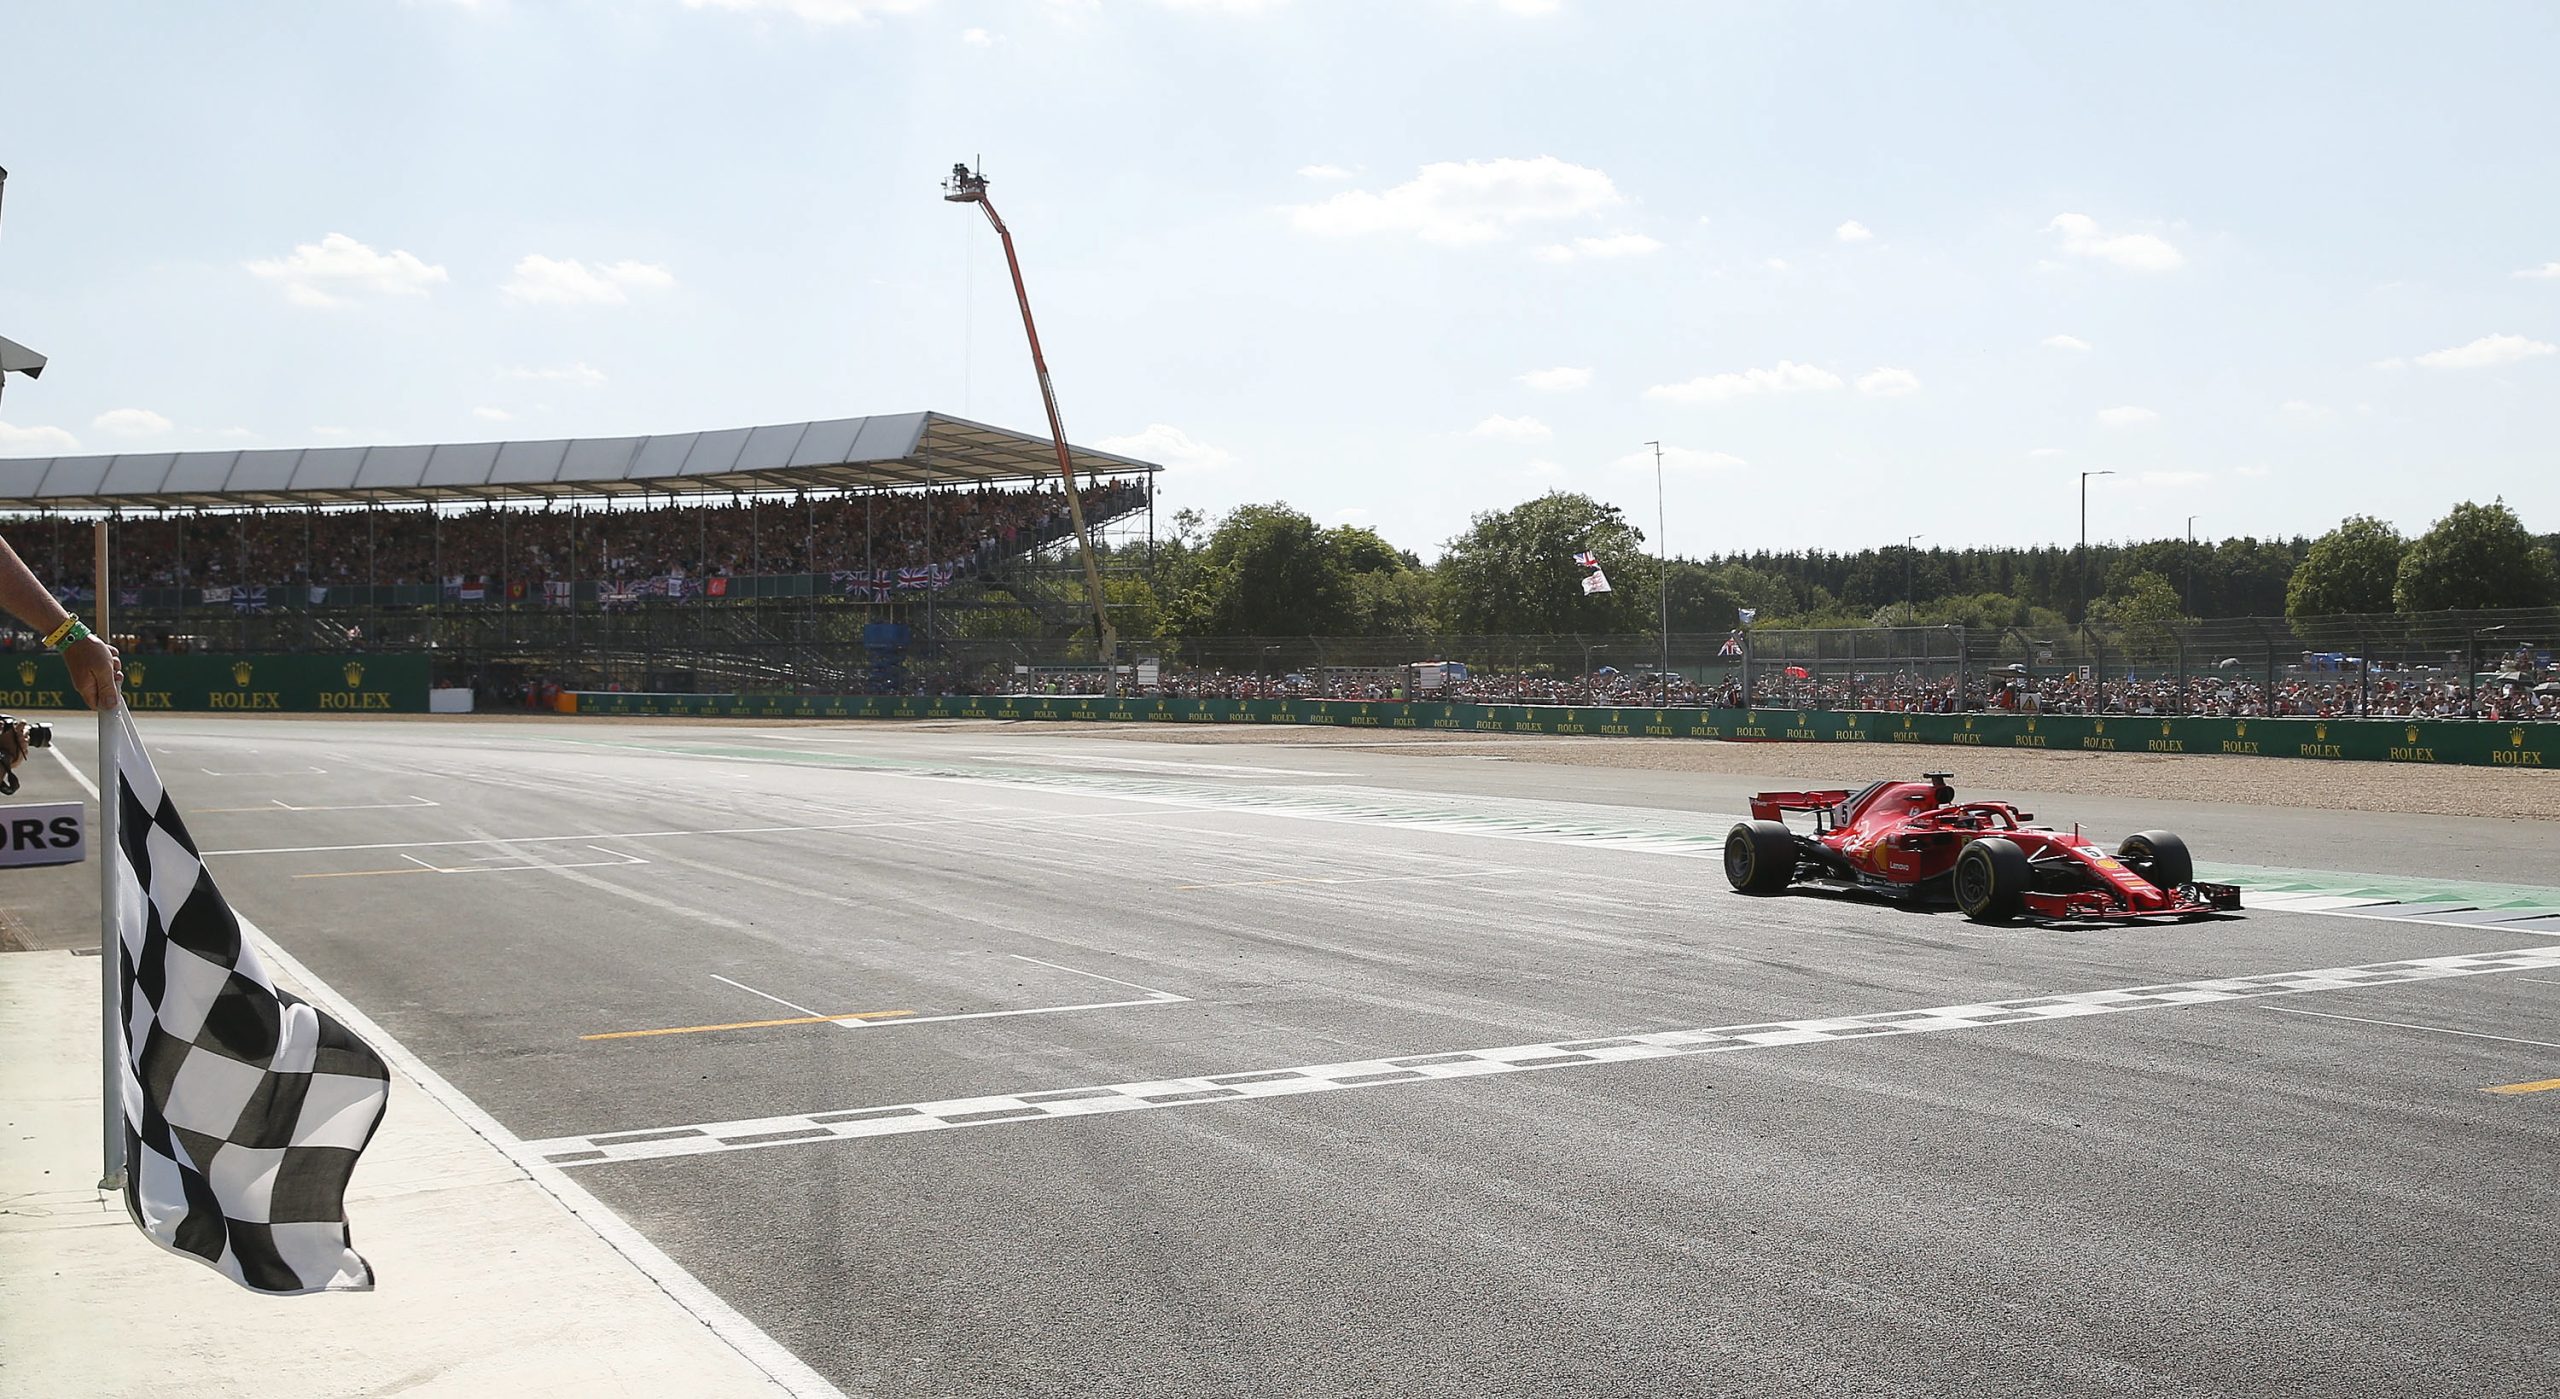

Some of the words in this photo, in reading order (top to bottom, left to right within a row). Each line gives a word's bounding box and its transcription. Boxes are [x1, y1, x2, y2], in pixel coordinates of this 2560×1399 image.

[2081, 667, 2088, 678] F
[209, 692, 280, 708] ROLEX
[320, 692, 391, 708] ROLEX
[1272, 714, 1296, 722] ROLEX
[1310, 715, 1334, 723] ROLEX
[1352, 716, 1378, 725] ROLEX
[1394, 717, 1416, 726] ROLEX
[1434, 719, 1459, 727] ROLEX
[1477, 720, 1502, 729] ROLEX
[1517, 722, 1543, 731] ROLEX
[1558, 724, 1583, 733] ROLEX
[1602, 725, 1628, 734] ROLEX
[1646, 726, 1672, 735] ROLEX
[1691, 727, 1718, 736] ROLEX
[1736, 727, 1765, 737] ROLEX
[1787, 729, 1815, 740] ROLEX
[1836, 730, 1866, 740] ROLEX
[1894, 732, 1919, 742] ROLEX
[1953, 733, 1981, 744] ROLEX
[2016, 735, 2045, 746] ROLEX
[2084, 737, 2115, 749] ROLEX
[2149, 740, 2184, 752] ROLEX
[2223, 741, 2258, 753] ROLEX
[2301, 743, 2341, 757] ROLEX
[2391, 747, 2434, 762] ROLEX
[2493, 751, 2541, 765] ROLEX
[1841, 805, 1848, 825] 5
[0, 817, 80, 851] RS
